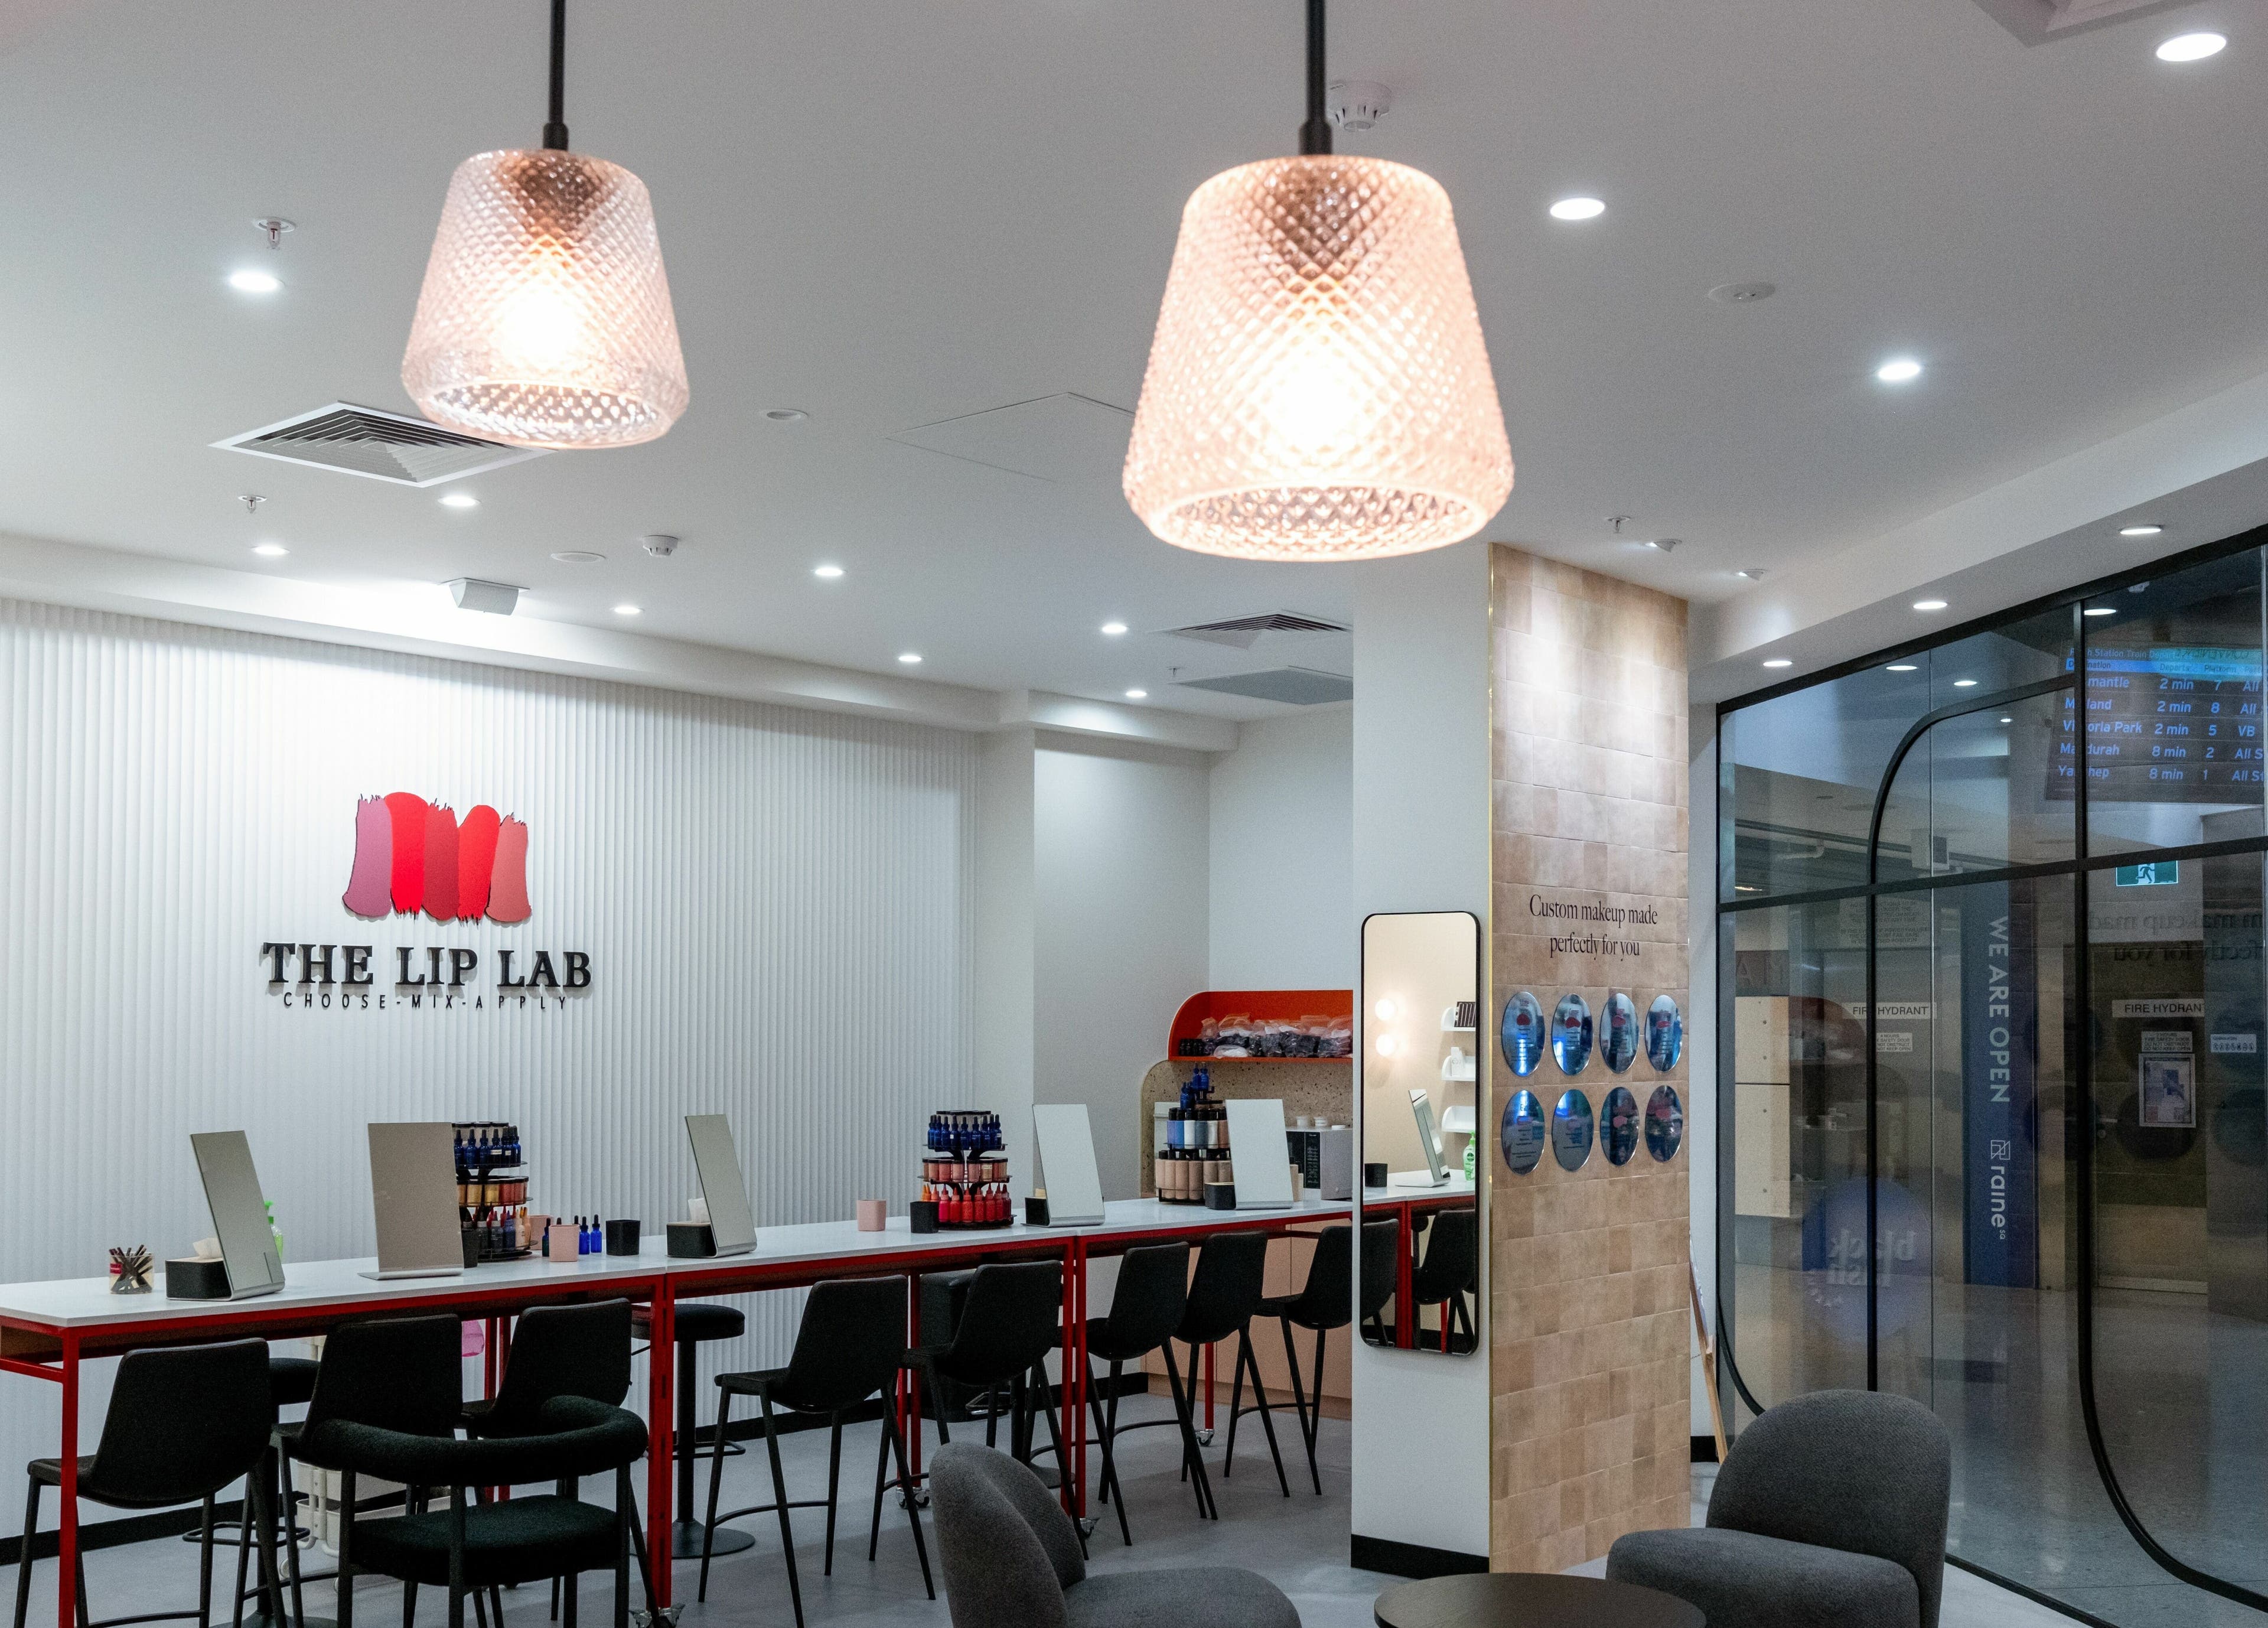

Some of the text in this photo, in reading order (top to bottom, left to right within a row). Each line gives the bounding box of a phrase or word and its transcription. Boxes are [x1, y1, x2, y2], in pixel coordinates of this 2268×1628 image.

[2094, 649, 2124, 658] Station
[2159, 678, 2168, 689] 2
[2172, 679, 2194, 690] min
[2214, 680, 2223, 691] 7
[2243, 680, 2259, 692] All
[2065, 697, 2257, 715] Mland 2 min 8 All
[2062, 719, 2256, 737] Vioria Park 2 min 5 VB
[2060, 742, 2120, 756] Madurah
[2152, 745, 2161, 757] 8
[2164, 746, 2186, 758] min
[2205, 747, 2214, 759] 2
[2234, 748, 2252, 760] All
[2058, 764, 2110, 779] Yahep
[2149, 768, 2158, 780] 8
[2162, 769, 2184, 781] min
[2202, 769, 2208, 780] 1
[2231, 770, 2249, 782] All
[1529, 894, 1658, 929] Custom makeup made
[1549, 932, 1640, 962] perfectly for you
[263, 942, 592, 989] THE LIP LAB
[1853, 1006, 1929, 1015] FIR HYDRANT
[1989, 916, 2010, 1102] WE ARE OPEN
[2124, 1004, 2150, 1013] FIRE
[1990, 1166, 2005, 1227] raine
